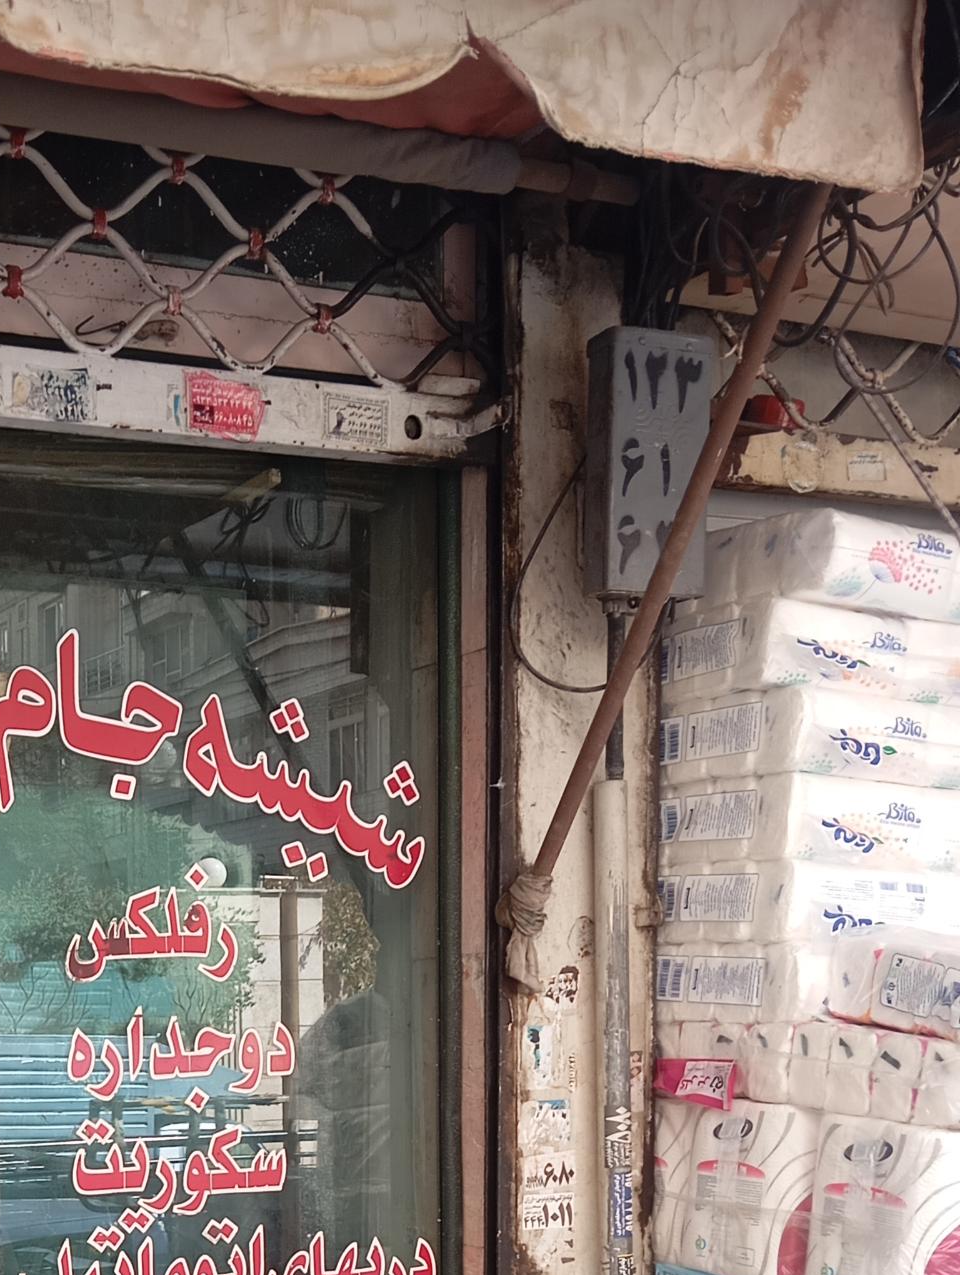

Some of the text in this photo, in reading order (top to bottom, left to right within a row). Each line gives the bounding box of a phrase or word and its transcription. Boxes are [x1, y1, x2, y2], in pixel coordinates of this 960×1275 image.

[182, 693, 425, 889] شیشه
[65, 862, 238, 983] رفلکس
[71, 1119, 288, 1234] سکوریت
